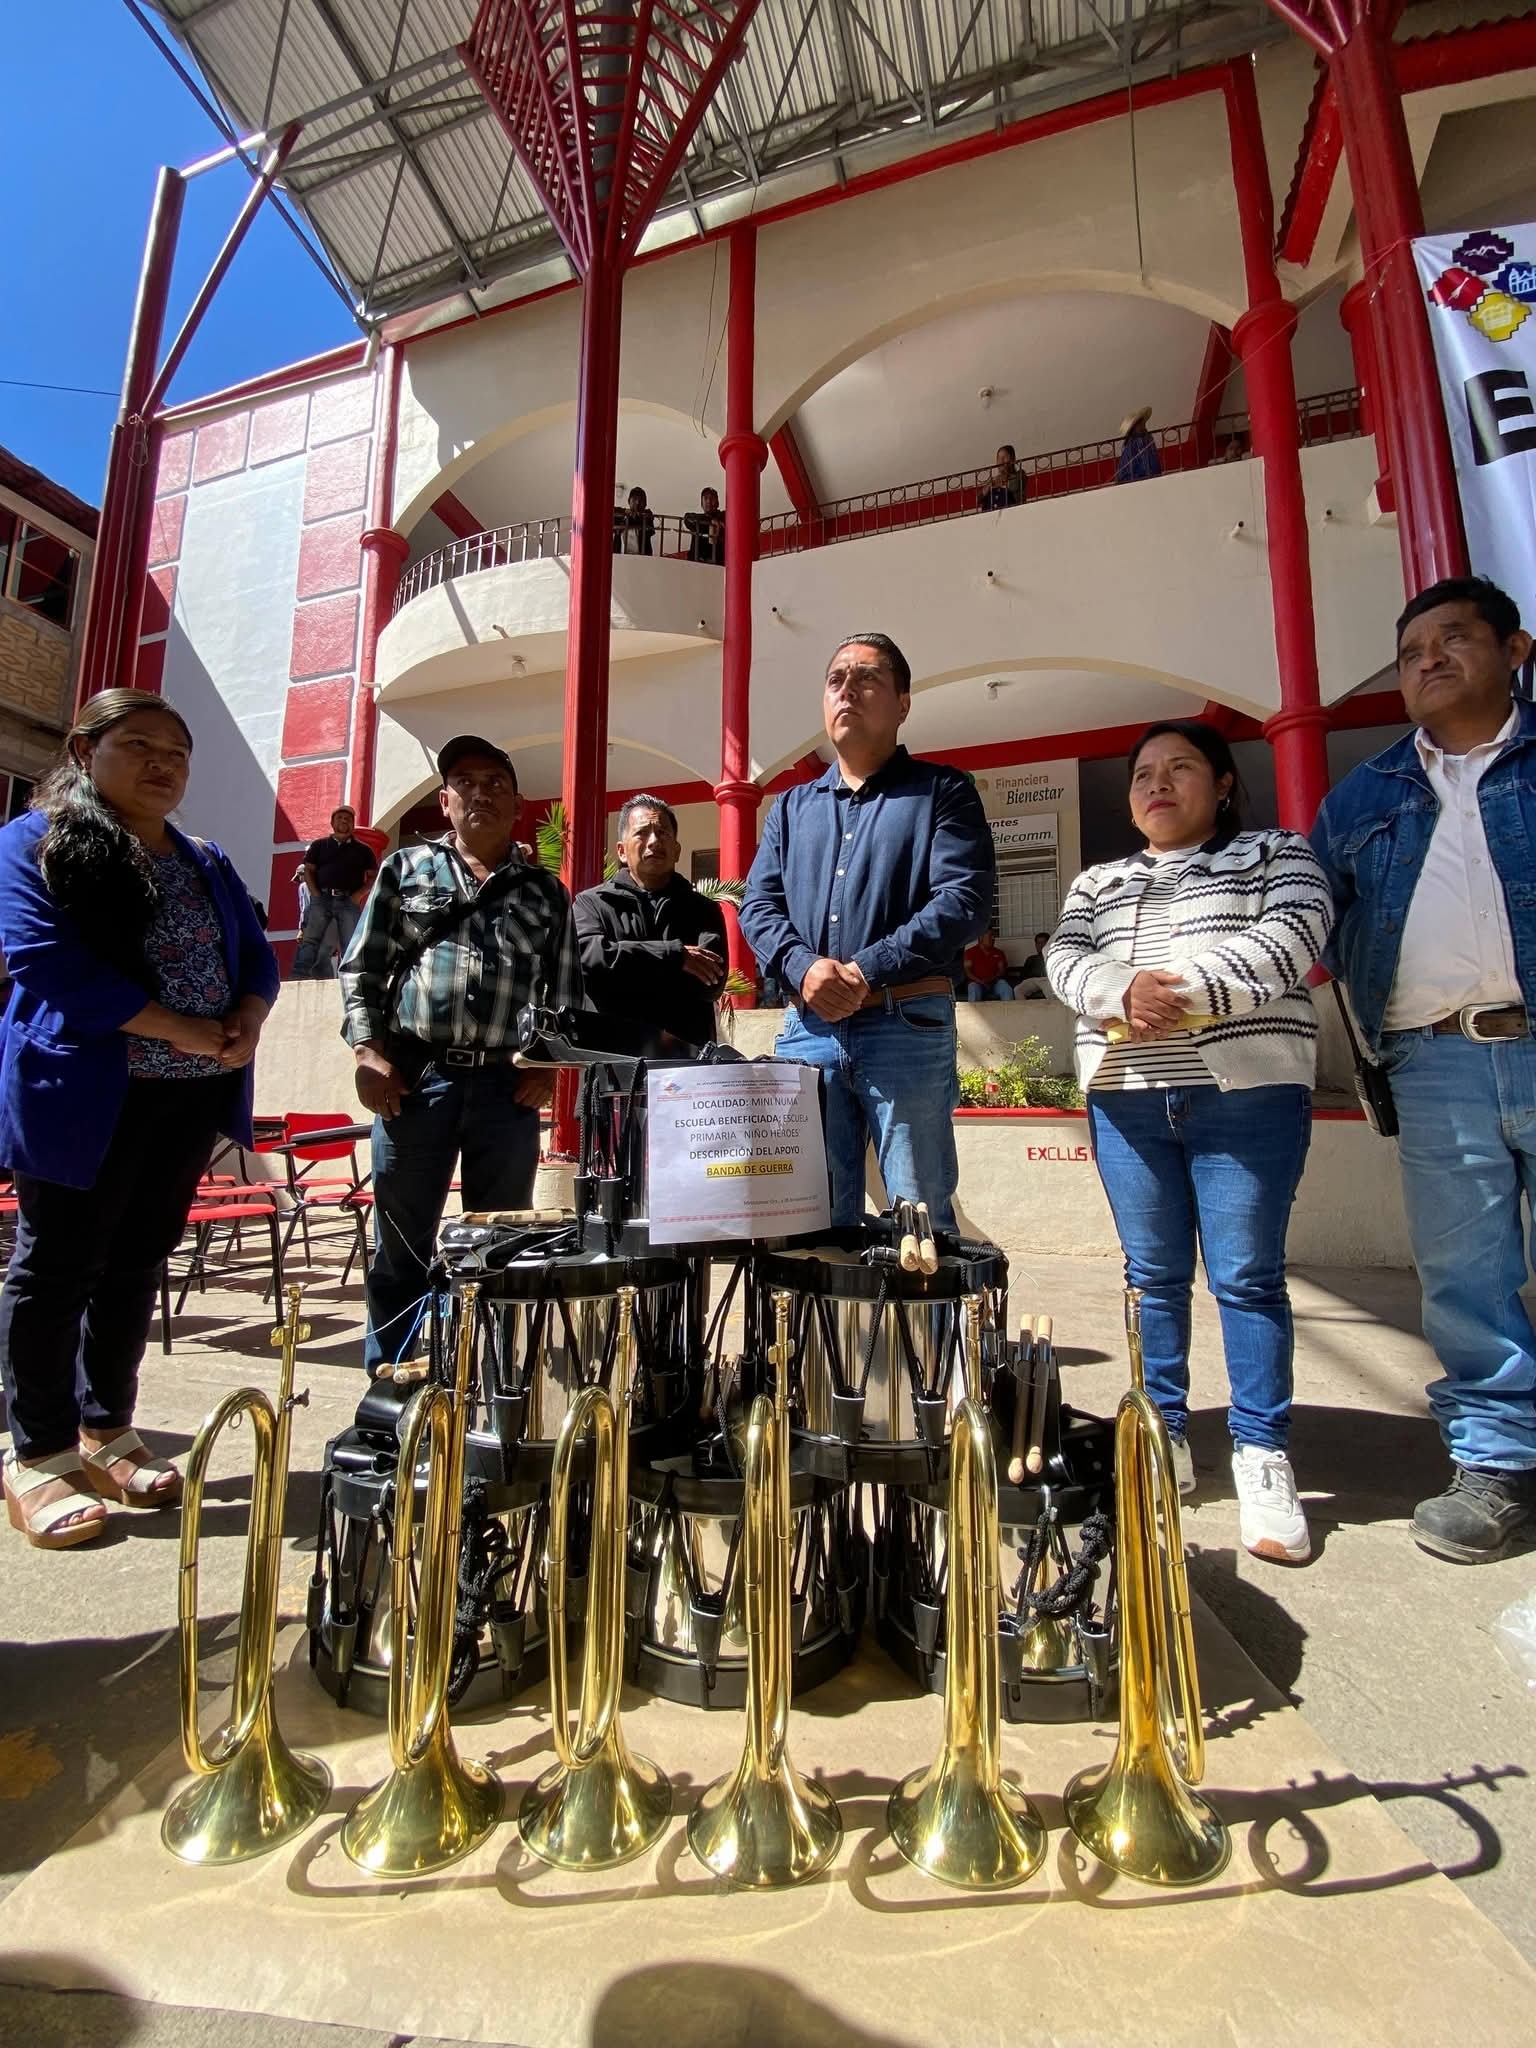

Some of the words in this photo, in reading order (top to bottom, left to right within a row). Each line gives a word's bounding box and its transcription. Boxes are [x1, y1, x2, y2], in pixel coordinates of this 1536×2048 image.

[995, 774, 1049, 790] Financiera
[1006, 786, 1064, 805] Bienestar
[692, 1098, 749, 1110] LOCALIDAD:
[751, 1098, 773, 1106] MINI
[775, 1097, 798, 1106] NUMA
[675, 1118, 716, 1128] ESCUELA
[783, 1114, 808, 1123] ESCUELA
[690, 1131, 737, 1142] PRIMARIA
[690, 1147, 753, 1159] DESCRIPCIÓN
[756, 1147, 772, 1156] DEL
[706, 1165, 741, 1176] BANDA
[744, 1165, 757, 1174] DE
[760, 1164, 794, 1173] GUERRA
